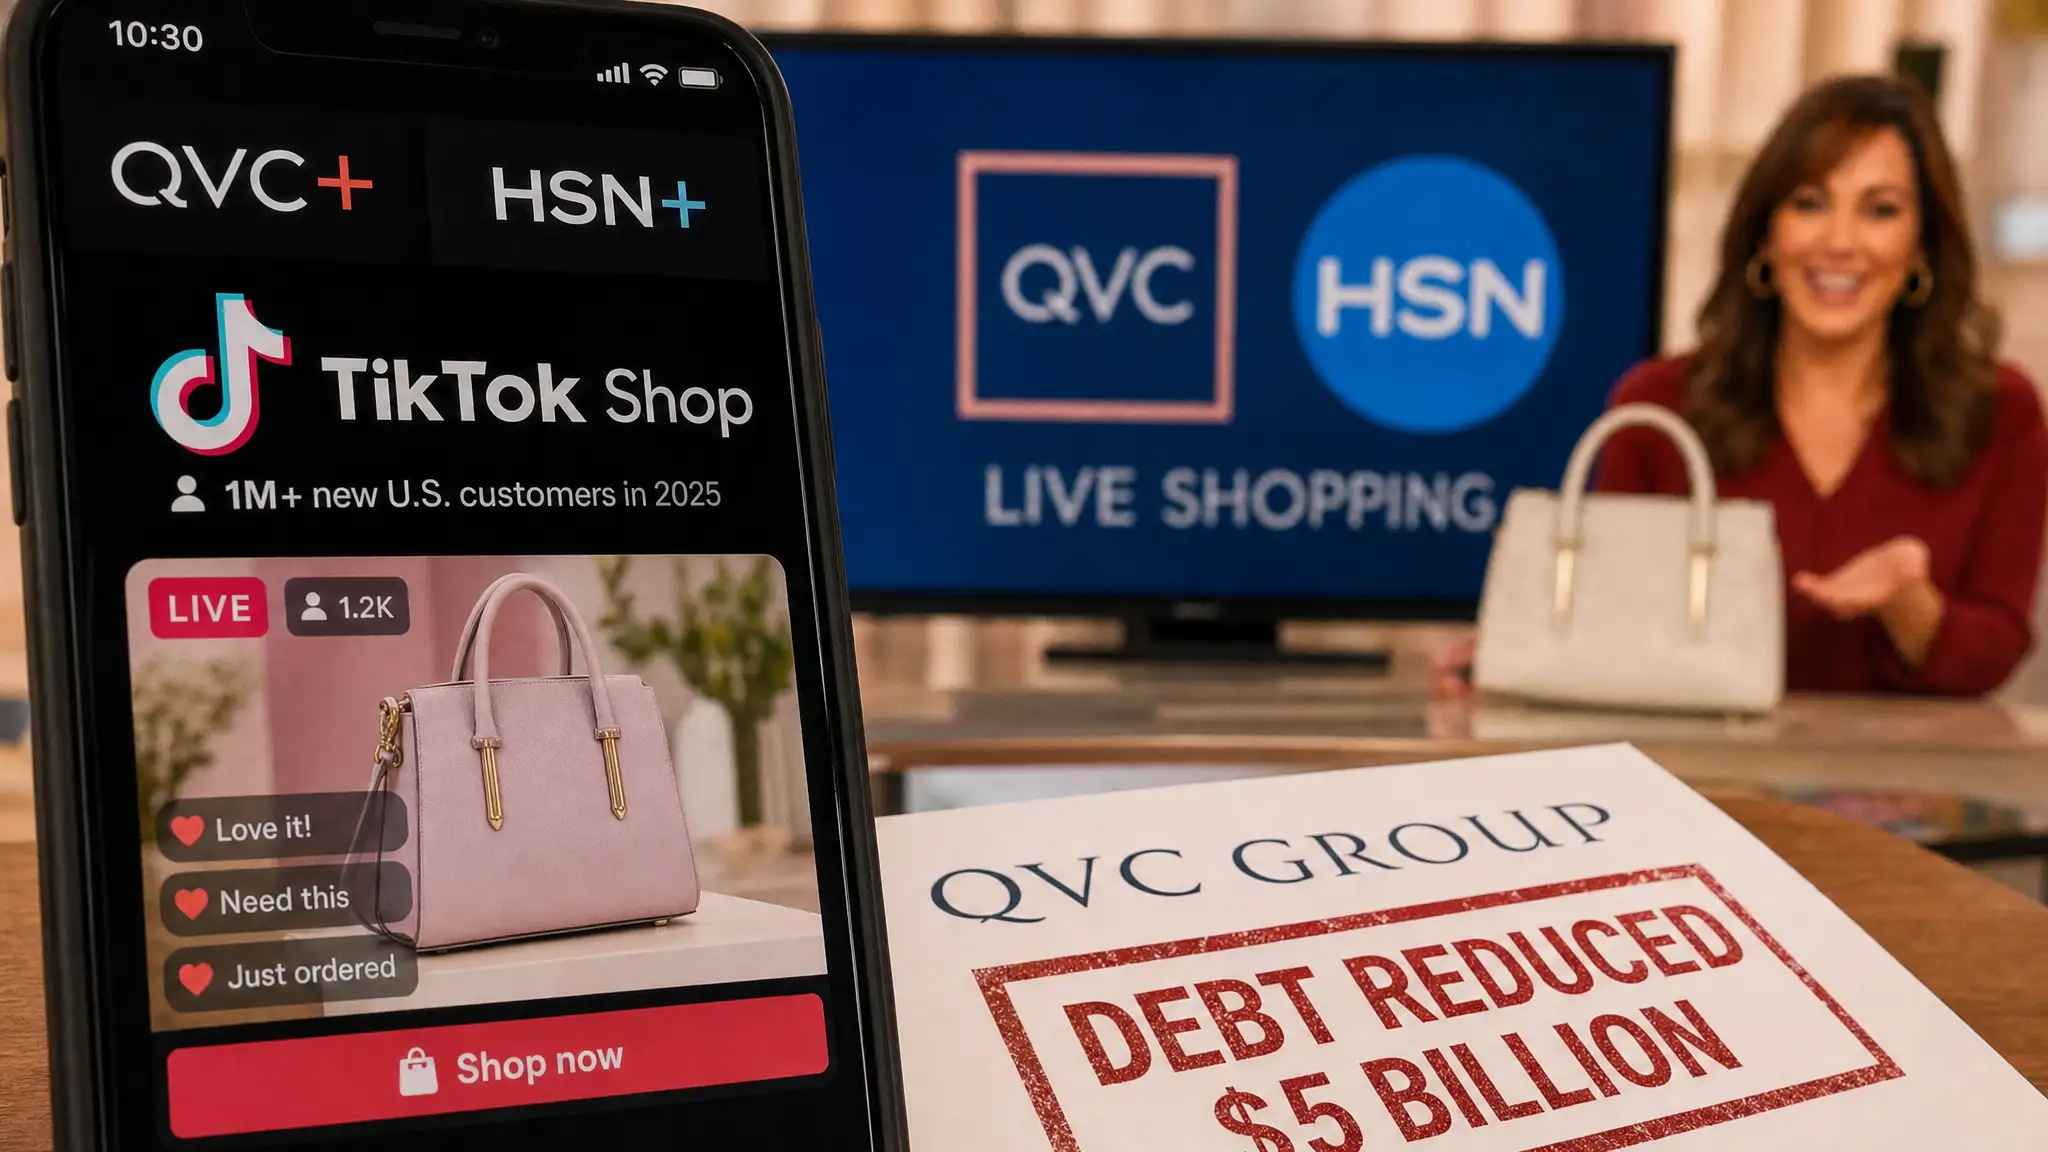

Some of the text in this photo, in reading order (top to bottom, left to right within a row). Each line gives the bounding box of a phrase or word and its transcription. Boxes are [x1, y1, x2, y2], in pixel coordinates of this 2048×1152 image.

[108, 20, 203, 52] 10:30
[111, 141, 373, 212] QVC+
[492, 166, 706, 229] HSN+
[1001, 244, 1193, 324] QVC
[1317, 256, 1546, 339] HSN
[320, 356, 754, 439] TikTok Shop
[225, 478, 721, 510] 1M+ new U.S. customers in 2025
[985, 466, 1496, 531] LIVE SHOPPING
[168, 594, 251, 623] LIVE
[339, 595, 395, 619] 1.2K
[216, 814, 311, 842] Love it!
[930, 804, 1610, 924] QVC GROUP
[220, 884, 350, 915] Need this
[227, 956, 396, 989] Just ordered
[1062, 905, 1744, 1086] DEBT REDUCED
[457, 1046, 624, 1086] Shop now
[1359, 999, 1743, 1142] BILLION
